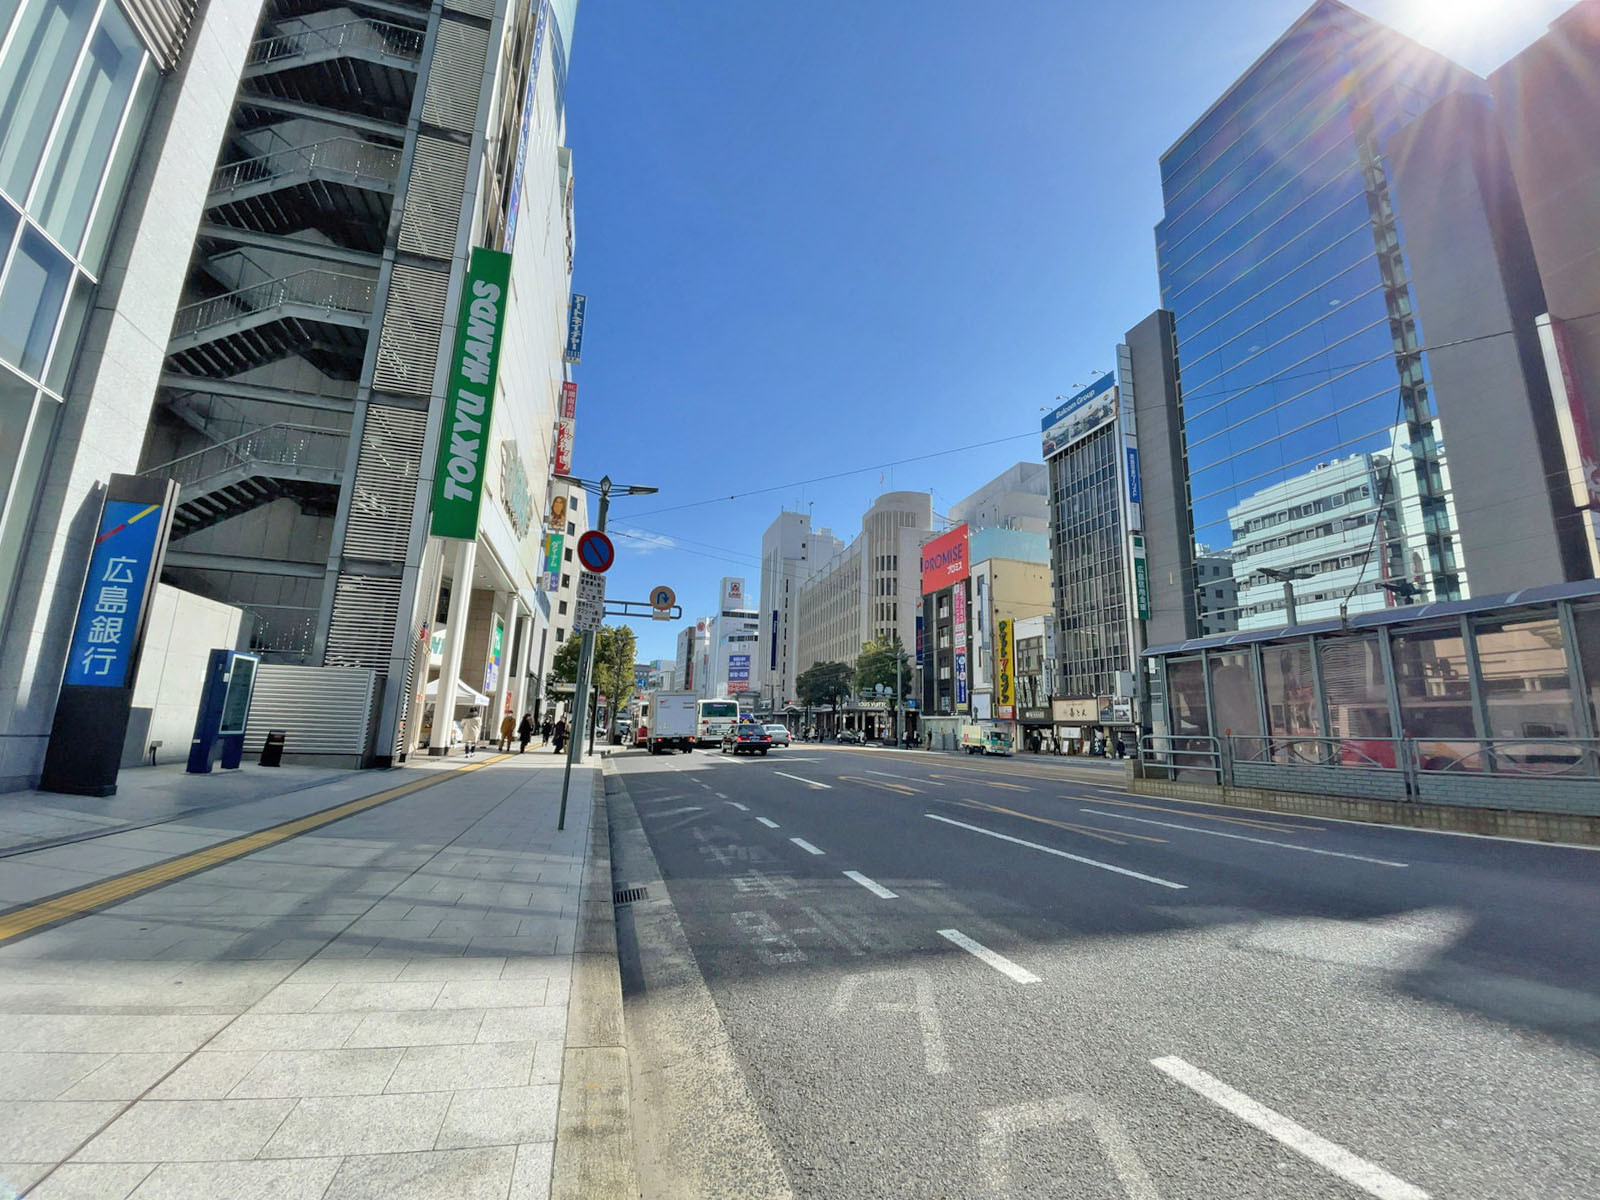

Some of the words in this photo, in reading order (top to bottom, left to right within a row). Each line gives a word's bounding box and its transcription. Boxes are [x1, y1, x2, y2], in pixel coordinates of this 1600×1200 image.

[461, 279, 501, 386] HANDS
[1076, 389, 1095, 405] Group
[443, 387, 486, 503] TOKYU
[924, 543, 963, 575] PROMISE
[947, 562, 963, 575] プロミス
[81, 555, 138, 676] 広島銀行
